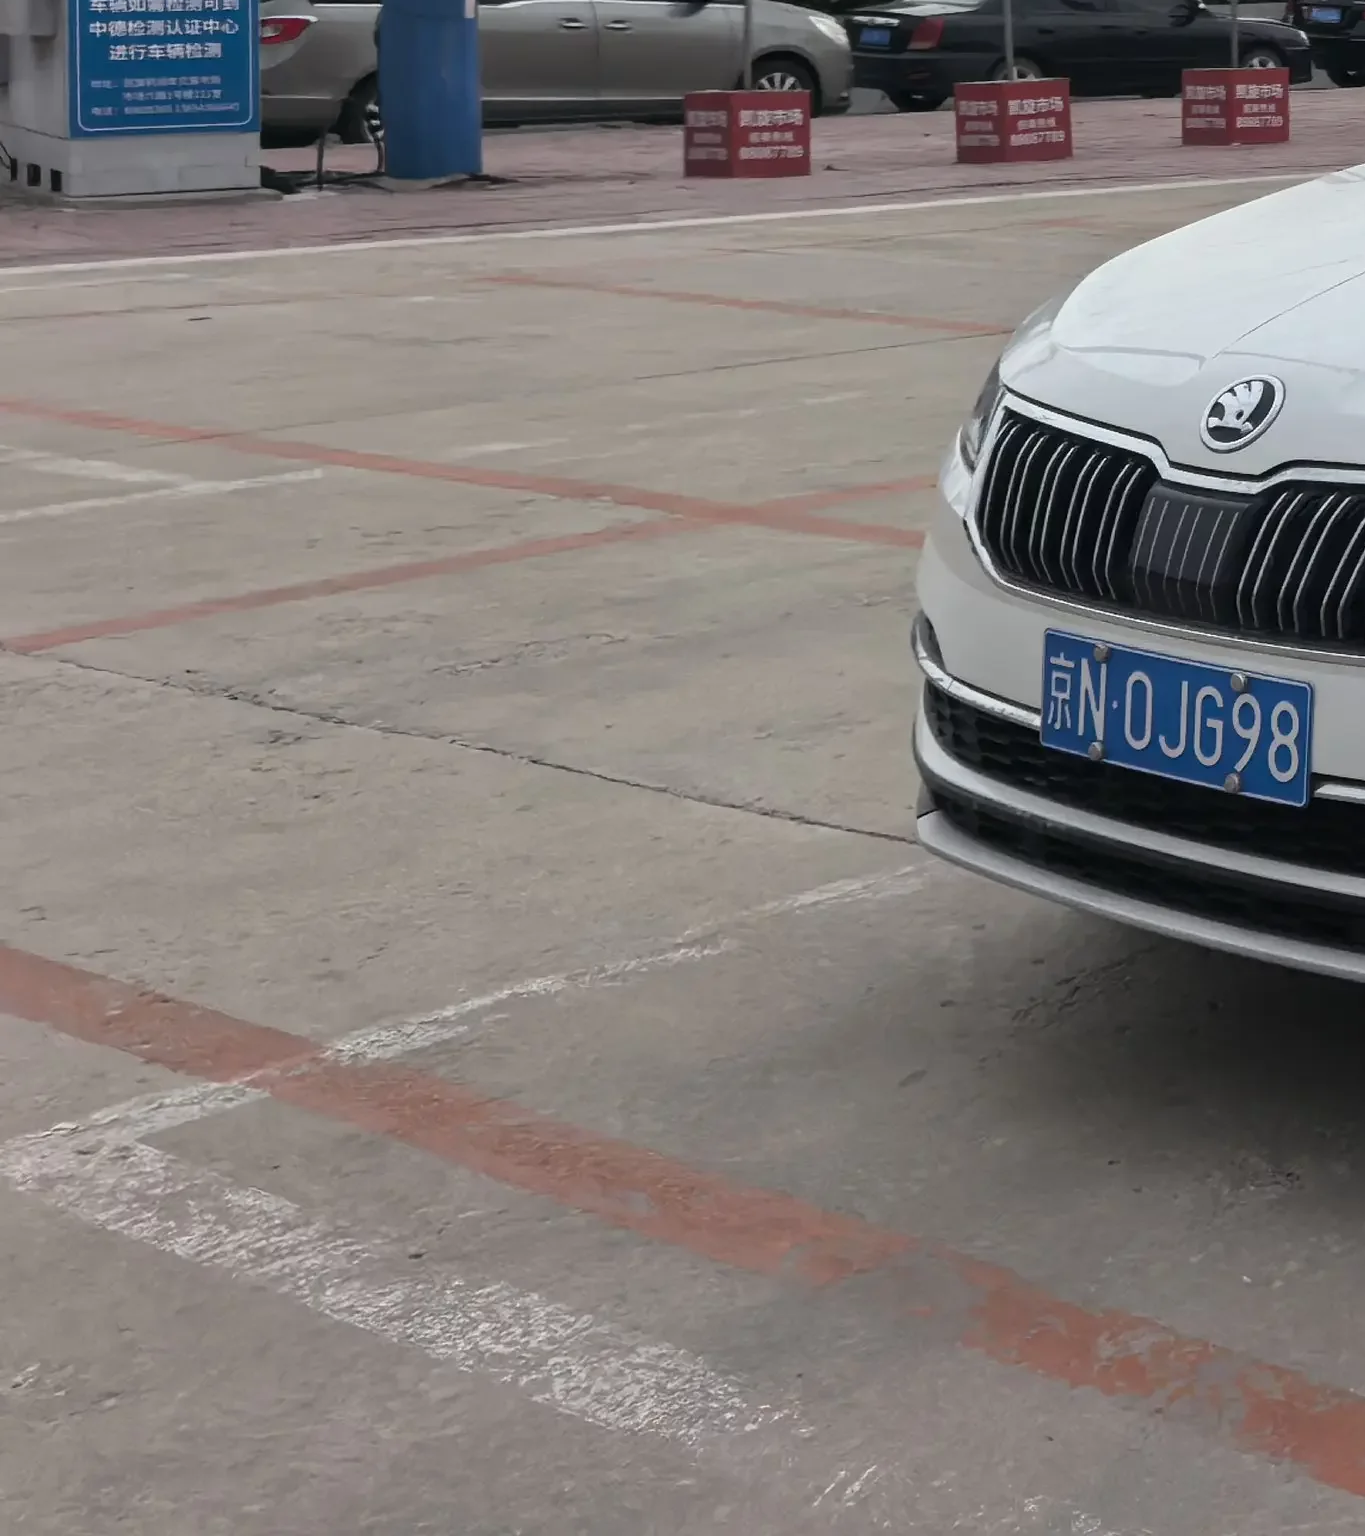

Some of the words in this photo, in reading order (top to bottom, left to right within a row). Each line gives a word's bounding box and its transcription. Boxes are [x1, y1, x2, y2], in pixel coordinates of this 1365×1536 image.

[89, 18, 240, 37] 中德检测认证中心
[109, 42, 222, 60] 进行车辆检测
